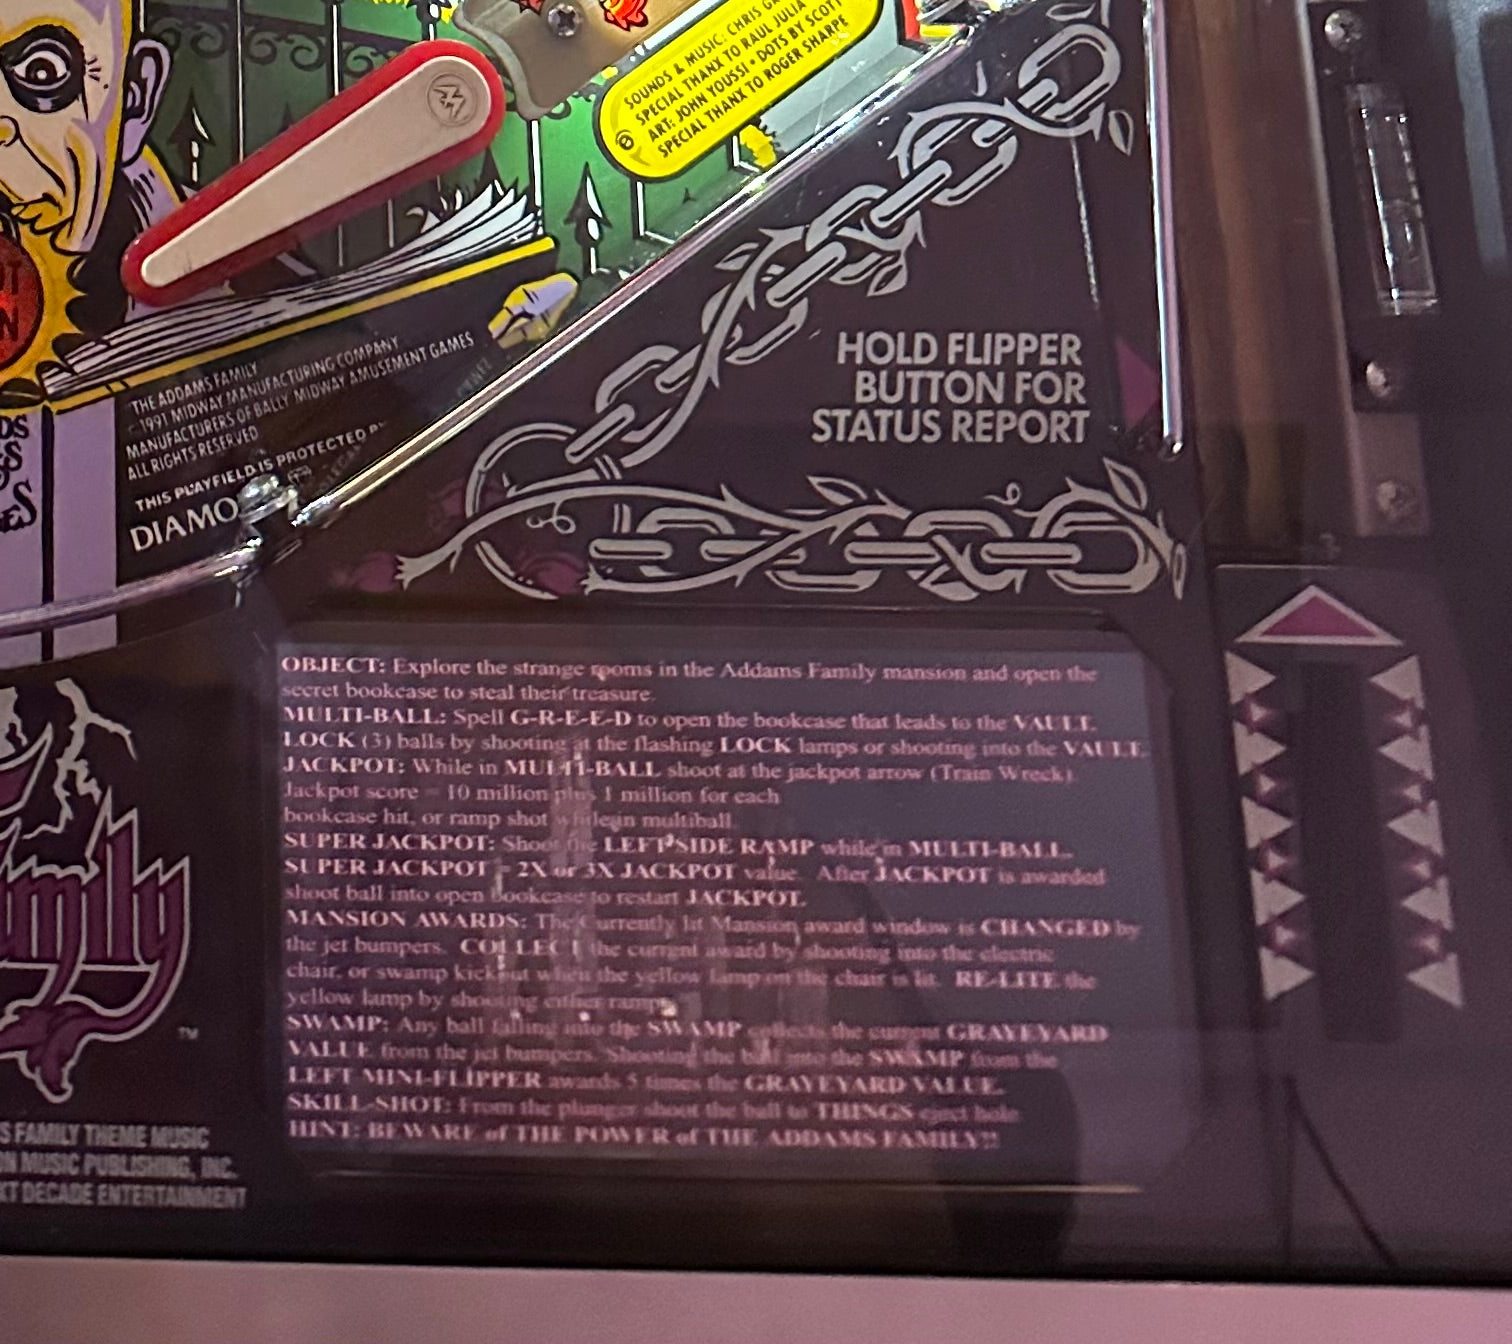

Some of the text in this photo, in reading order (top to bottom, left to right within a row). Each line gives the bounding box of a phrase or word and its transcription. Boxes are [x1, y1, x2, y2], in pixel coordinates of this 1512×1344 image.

[624, 69, 672, 110] SOUNDS
[676, 63, 685, 75] &
[685, 33, 727, 65] MUSIC:
[727, 8, 762, 36] CHRIS
[635, 83, 685, 125] SPECIAL
[682, 57, 724, 88] THANX
[723, 44, 742, 62] TO
[743, 25, 773, 50] RAUL
[647, 118, 675, 143] ART:
[677, 93, 709, 121] JOHN
[709, 65, 748, 97] YOUSSI
[756, 34, 788, 62] DOTS
[788, 20, 808, 40] BY
[658, 14, 850, 158] SPECIAL THANX TO ROGER SHARPE
[838, 331, 1082, 365] HOLD FLIPPER
[126, 414, 235, 460] MANUFACTURERS
[237, 409, 252, 427] OF
[254, 394, 289, 418] BALLY
[293, 378, 346, 404] MIDWAY
[350, 346, 426, 386] AMUSEMENT
[430, 331, 475, 360] GAMES
[132, 363, 259, 415] THE ADDAMS FAMILY
[140, 336, 399, 433] 1991 MIDWAY MANUFACTURING COMPANY
[856, 370, 1086, 405] BUTTON FOR
[811, 408, 1090, 444] STATUS REPORT
[127, 425, 259, 481] ALL RIGHTS RESERVED
[136, 489, 173, 512] THIS
[258, 457, 273, 473] IS
[277, 427, 367, 465] PROTECTED
[281, 657, 385, 677] OBJECT:
[393, 659, 471, 680] Explore
[477, 659, 506, 677] the
[513, 662, 584, 681] strange
[658, 662, 677, 678] in
[684, 663, 714, 679] the
[721, 663, 802, 680] Addams
[808, 664, 876, 683] Family
[883, 666, 966, 682] mansion
[973, 666, 1007, 682] and
[1014, 669, 1062, 685] open
[1068, 666, 1097, 682] the
[283, 707, 631, 728] MULTI-BALL: Spell G-R-E-E-D
[15, 1121, 80, 1146] FAMILY
[83, 1124, 149, 1147] THEME
[150, 1125, 209, 1149] MUSIC
[20, 1151, 80, 1175] MUSIC
[21, 1181, 94, 1205] DECADE
